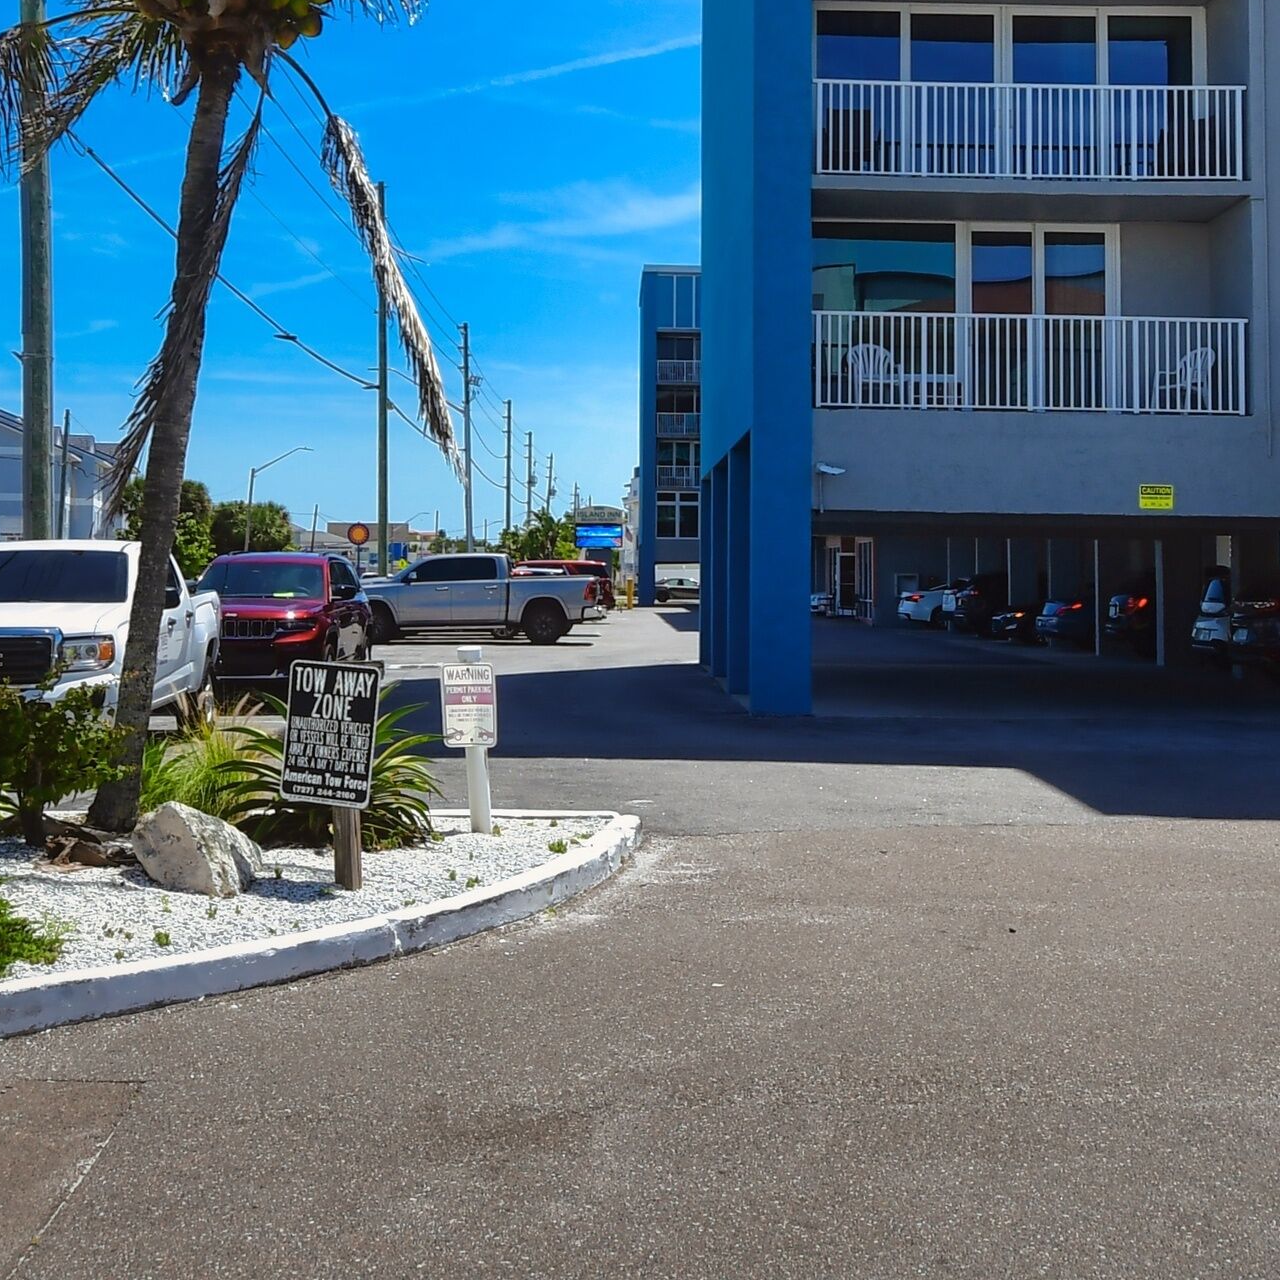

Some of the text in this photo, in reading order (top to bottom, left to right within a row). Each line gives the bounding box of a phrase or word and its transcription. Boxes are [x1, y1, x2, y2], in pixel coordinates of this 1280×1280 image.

[1141, 486, 1171, 494] CAUTION
[295, 667, 376, 698] TOW AWAY
[446, 669, 490, 681] WARNING
[446, 686, 492, 694] PERMIT PARKING
[461, 695, 477, 703] ONLY
[311, 693, 354, 721] ZONE
[291, 716, 371, 736] UNAUTHORIZED VEHICLES
[289, 728, 370, 750] OR VESSELS WILL BE TOWED
[289, 742, 368, 763] AWAY AT OWNERS EXPENSE
[287, 755, 296, 766] 24
[310, 757, 315, 768] A
[316, 758, 328, 770] DAY
[328, 760, 333, 770] 7
[334, 760, 349, 773] DAYS
[349, 762, 355, 773] A
[284, 768, 368, 791] American Tow Force
[292, 785, 356, 800] (727) 244-2160
